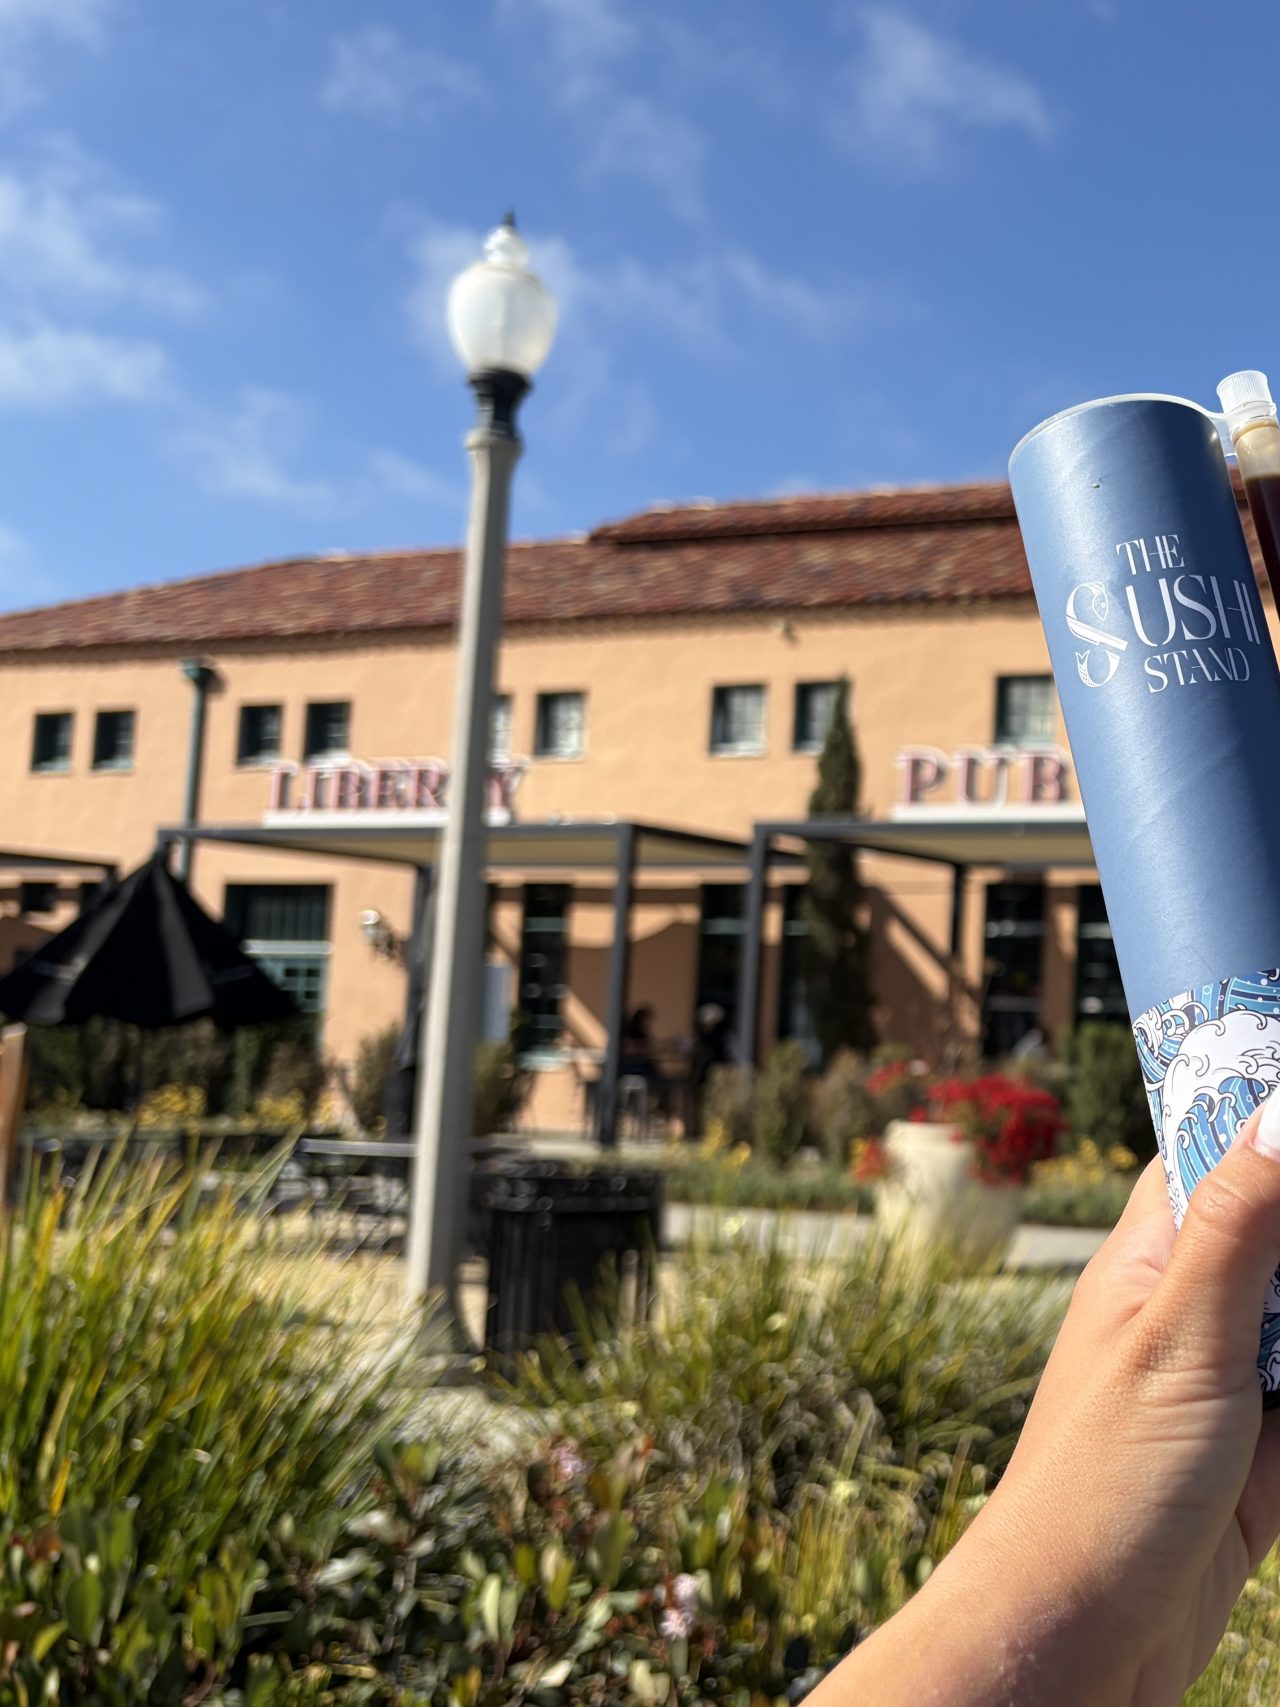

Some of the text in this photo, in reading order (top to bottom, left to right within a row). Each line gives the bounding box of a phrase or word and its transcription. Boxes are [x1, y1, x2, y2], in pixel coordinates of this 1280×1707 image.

[1115, 534, 1184, 575] THE
[1143, 647, 1250, 693] STAND
[266, 757, 530, 812] LIBERY
[893, 745, 1072, 810] PUB
